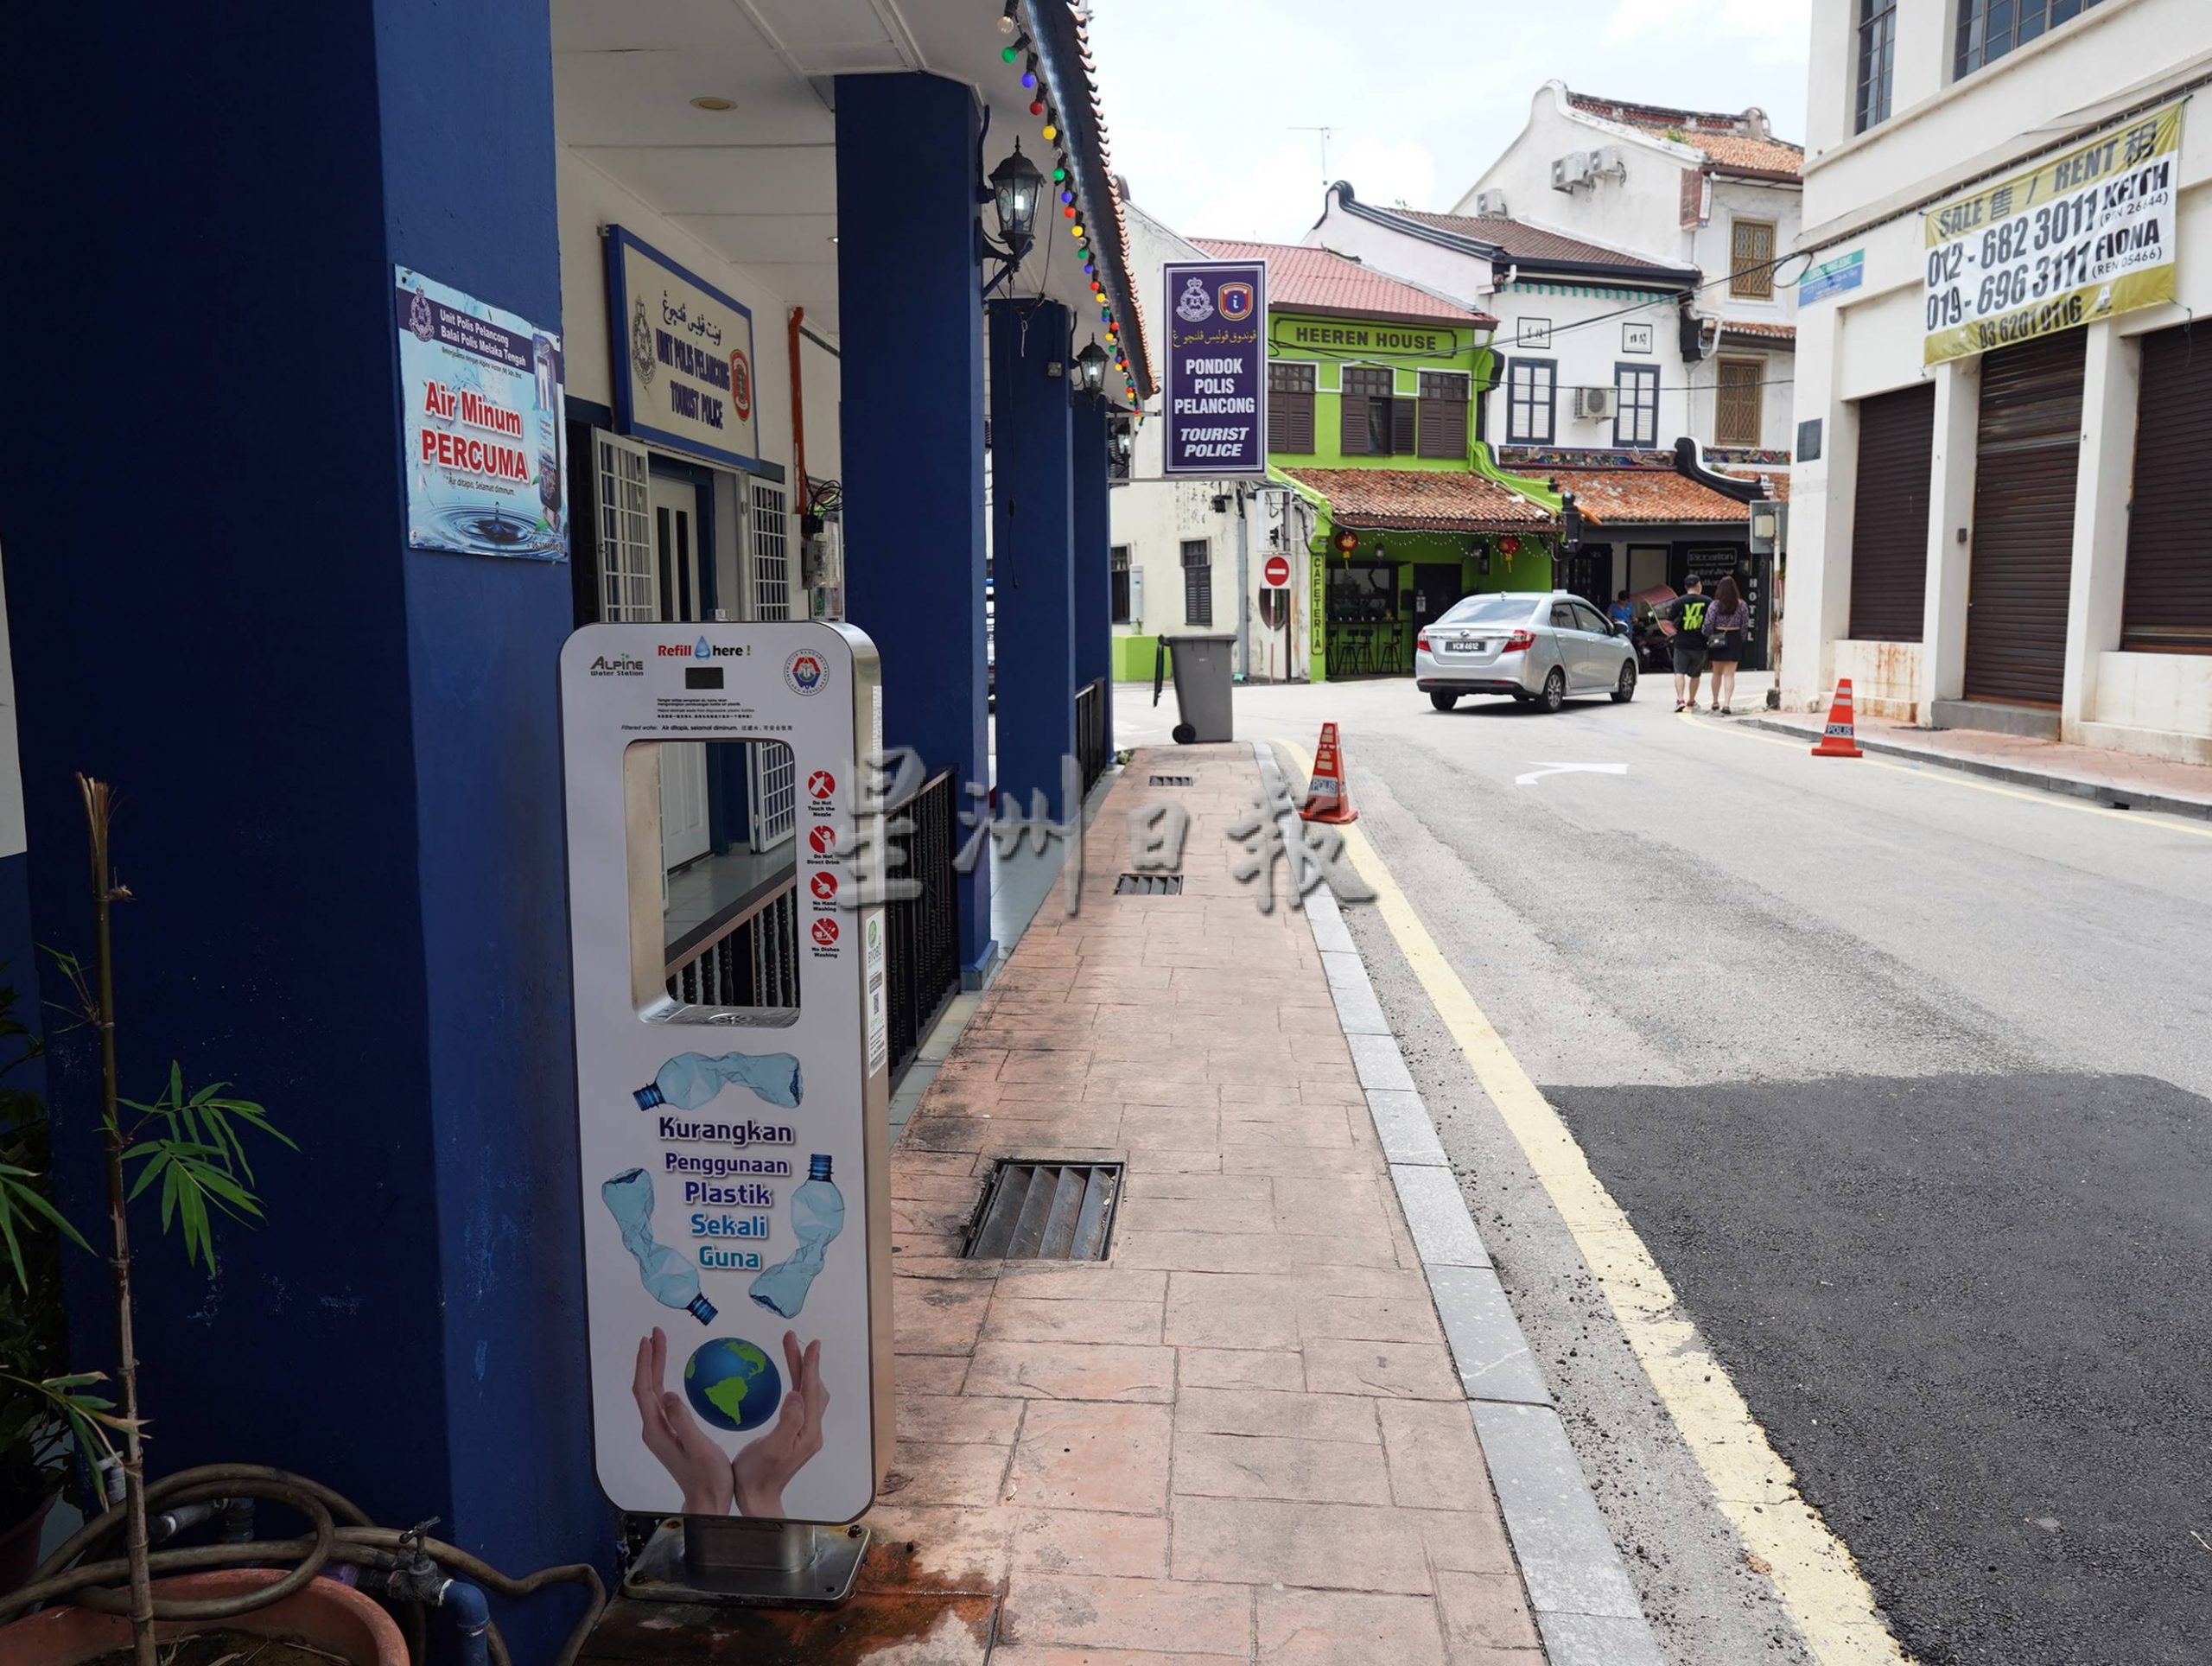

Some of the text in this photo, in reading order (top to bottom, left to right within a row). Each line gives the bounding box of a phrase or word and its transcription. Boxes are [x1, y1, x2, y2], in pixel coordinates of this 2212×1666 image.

[1939, 198, 1983, 237] SALE
[2054, 138, 2120, 193] RENT
[2102, 161, 2170, 210] KEITH
[1928, 242, 1964, 288] 012
[1980, 217, 2029, 270] 682
[2034, 188, 2098, 251] 3011
[2095, 218, 2160, 262] FIONA
[1927, 286, 1962, 331] 019
[1977, 264, 2029, 315] 696
[2032, 240, 2092, 298] 3111
[440, 308, 509, 348] Unit Polis Pelancong
[1296, 327, 1437, 351] HEEREN HOUSE
[1980, 321, 1997, 348] 03
[1999, 308, 2037, 343] 6201
[440, 325, 460, 343] Balai
[461, 332, 478, 349] Polis
[479, 340, 503, 358] Melaka
[504, 348, 526, 367] Tengah
[656, 327, 731, 392] UNIT POLIS PELANCONG
[1185, 358, 1243, 375] PONDOK
[1194, 378, 1236, 395] POLIS
[424, 381, 521, 436] Air Minum
[670, 380, 724, 430] TOURIST POLICE
[1174, 397, 1255, 415] PELANCONG
[1180, 427, 1249, 442] TOURIST
[421, 429, 529, 480] PERCUMA
[1184, 443, 1243, 458] POLICE
[1313, 556, 1322, 649] CAFETERIA
[1747, 577, 1758, 641] HOTEL
[590, 654, 644, 671] ALPINE
[658, 645, 692, 657] Refill
[712, 645, 743, 657] here
[1827, 725, 1853, 736] POLIS
[1313, 779, 1338, 793] POLIS
[658, 1116, 792, 1144] Kurangkan
[664, 1152, 789, 1175] Penggunaan
[684, 1181, 772, 1205] Plastik
[690, 1213, 767, 1237] Sekali
[698, 1245, 760, 1269] Guna
